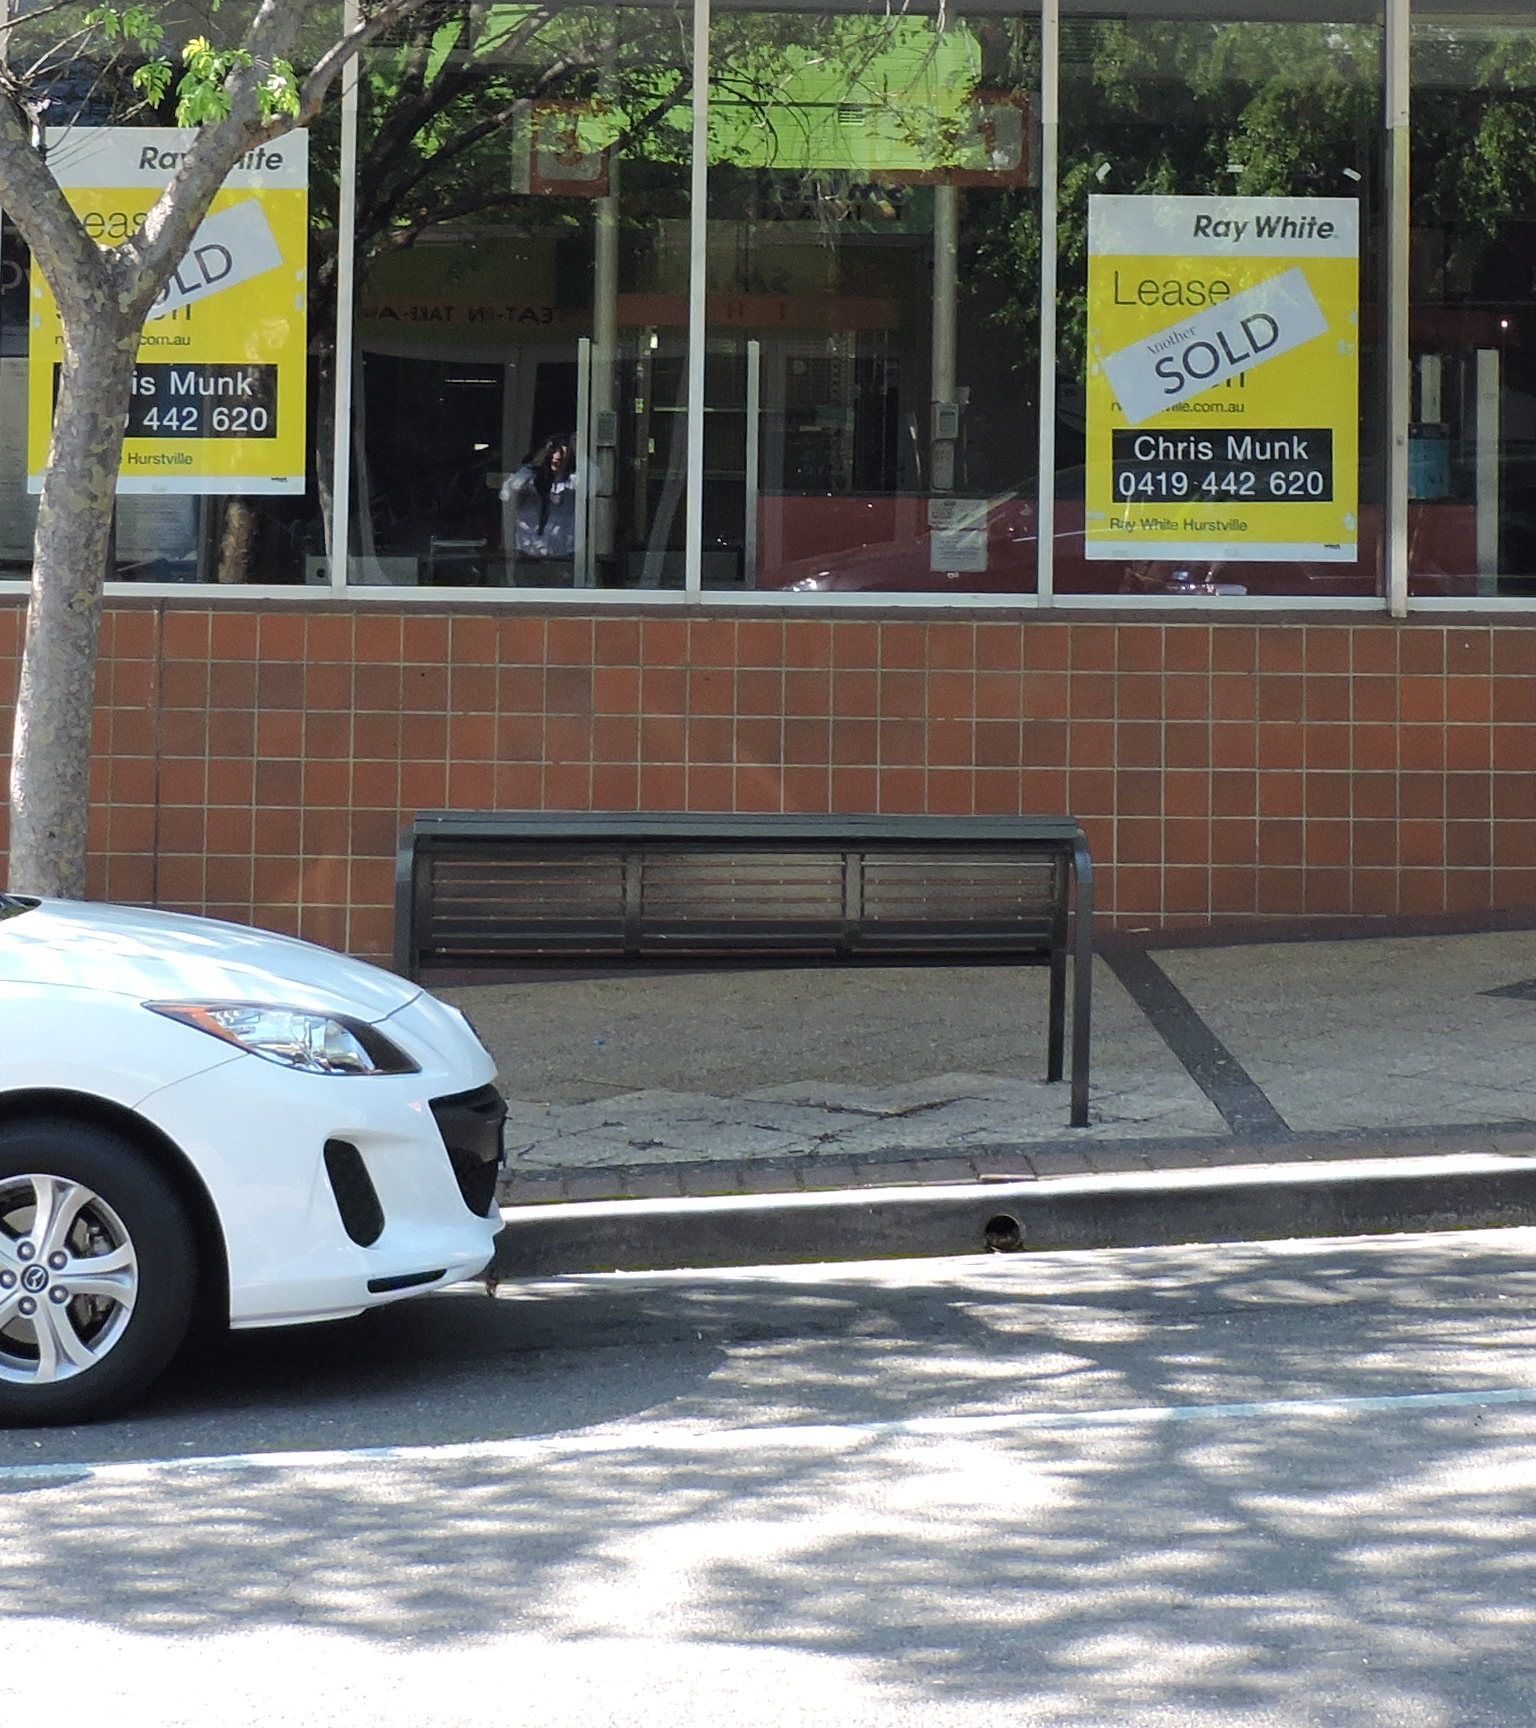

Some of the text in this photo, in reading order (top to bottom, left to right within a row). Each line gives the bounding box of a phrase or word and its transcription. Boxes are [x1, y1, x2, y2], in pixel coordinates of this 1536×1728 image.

[1193, 214, 1335, 243] Ray White
[1114, 270, 1231, 306] Lease
[1154, 313, 1280, 395] SOLD
[170, 370, 253, 396] Munk
[143, 406, 198, 432] 442
[213, 406, 267, 432] 620
[127, 452, 193, 465] Hurstville
[1134, 435, 1309, 461] Chris Munk
[1118, 471, 1324, 496] 0419 442 620
[1109, 517, 1248, 533] Ray White Hurstville
